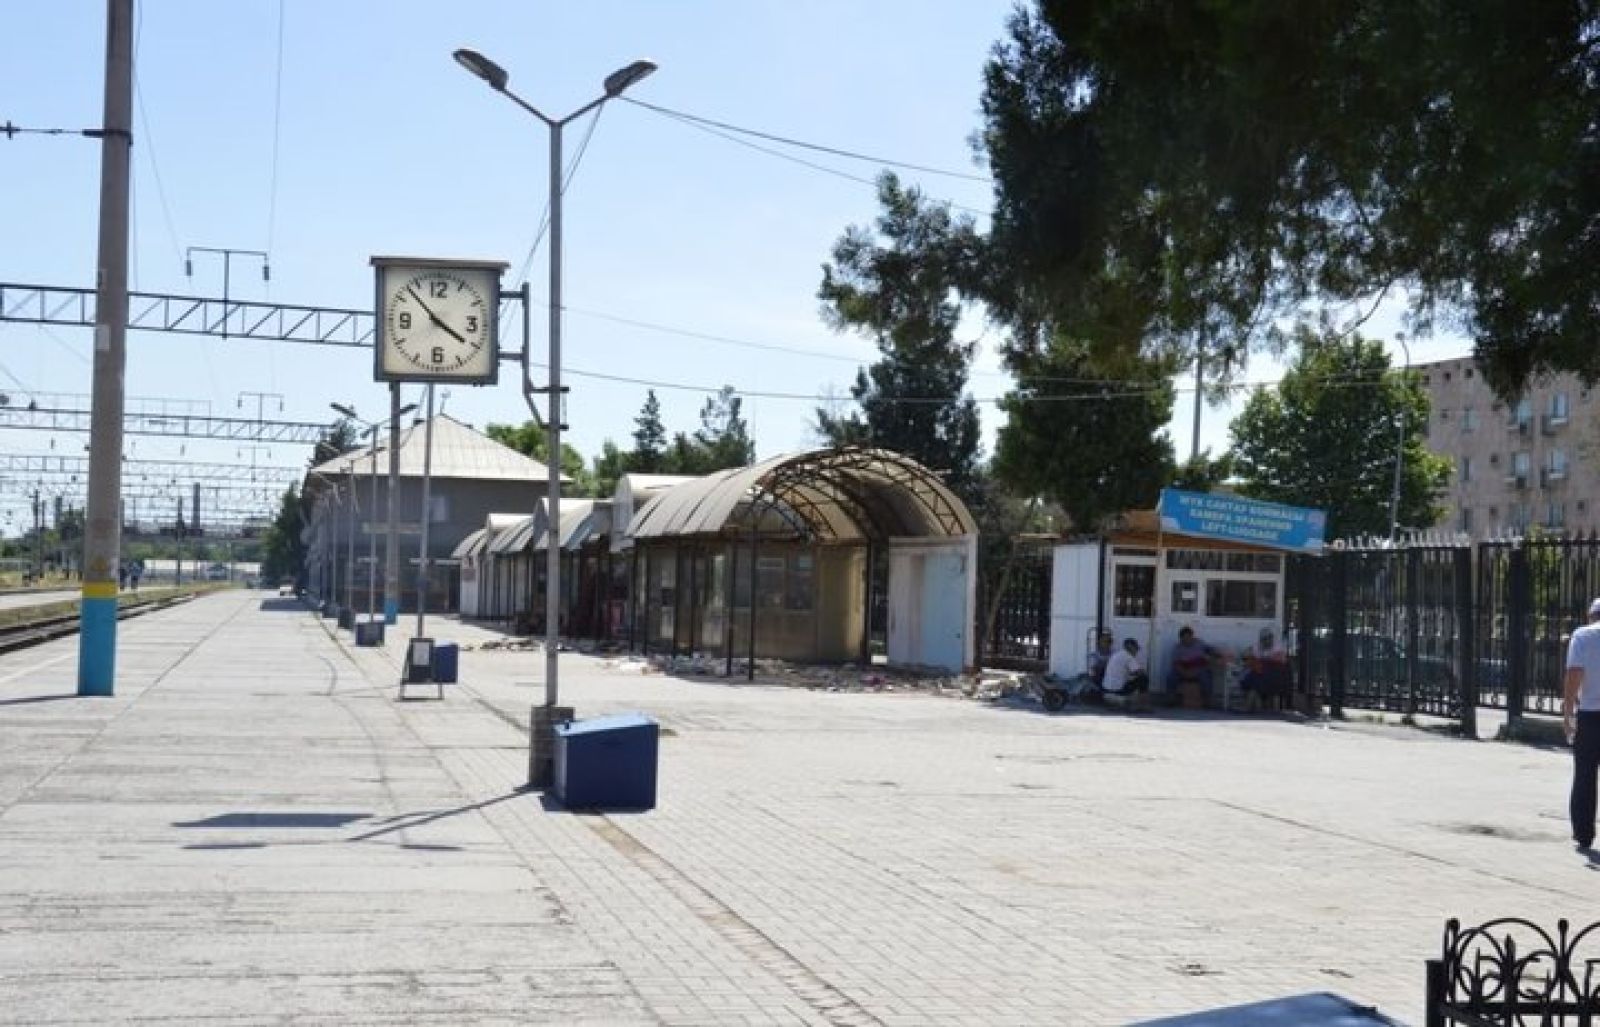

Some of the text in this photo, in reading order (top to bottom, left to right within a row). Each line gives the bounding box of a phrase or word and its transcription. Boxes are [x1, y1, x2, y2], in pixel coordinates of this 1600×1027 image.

[430, 281, 448, 298] 12
[399, 312, 412, 329] 9
[466, 316, 478, 333] 3
[431, 346, 445, 363] 6
